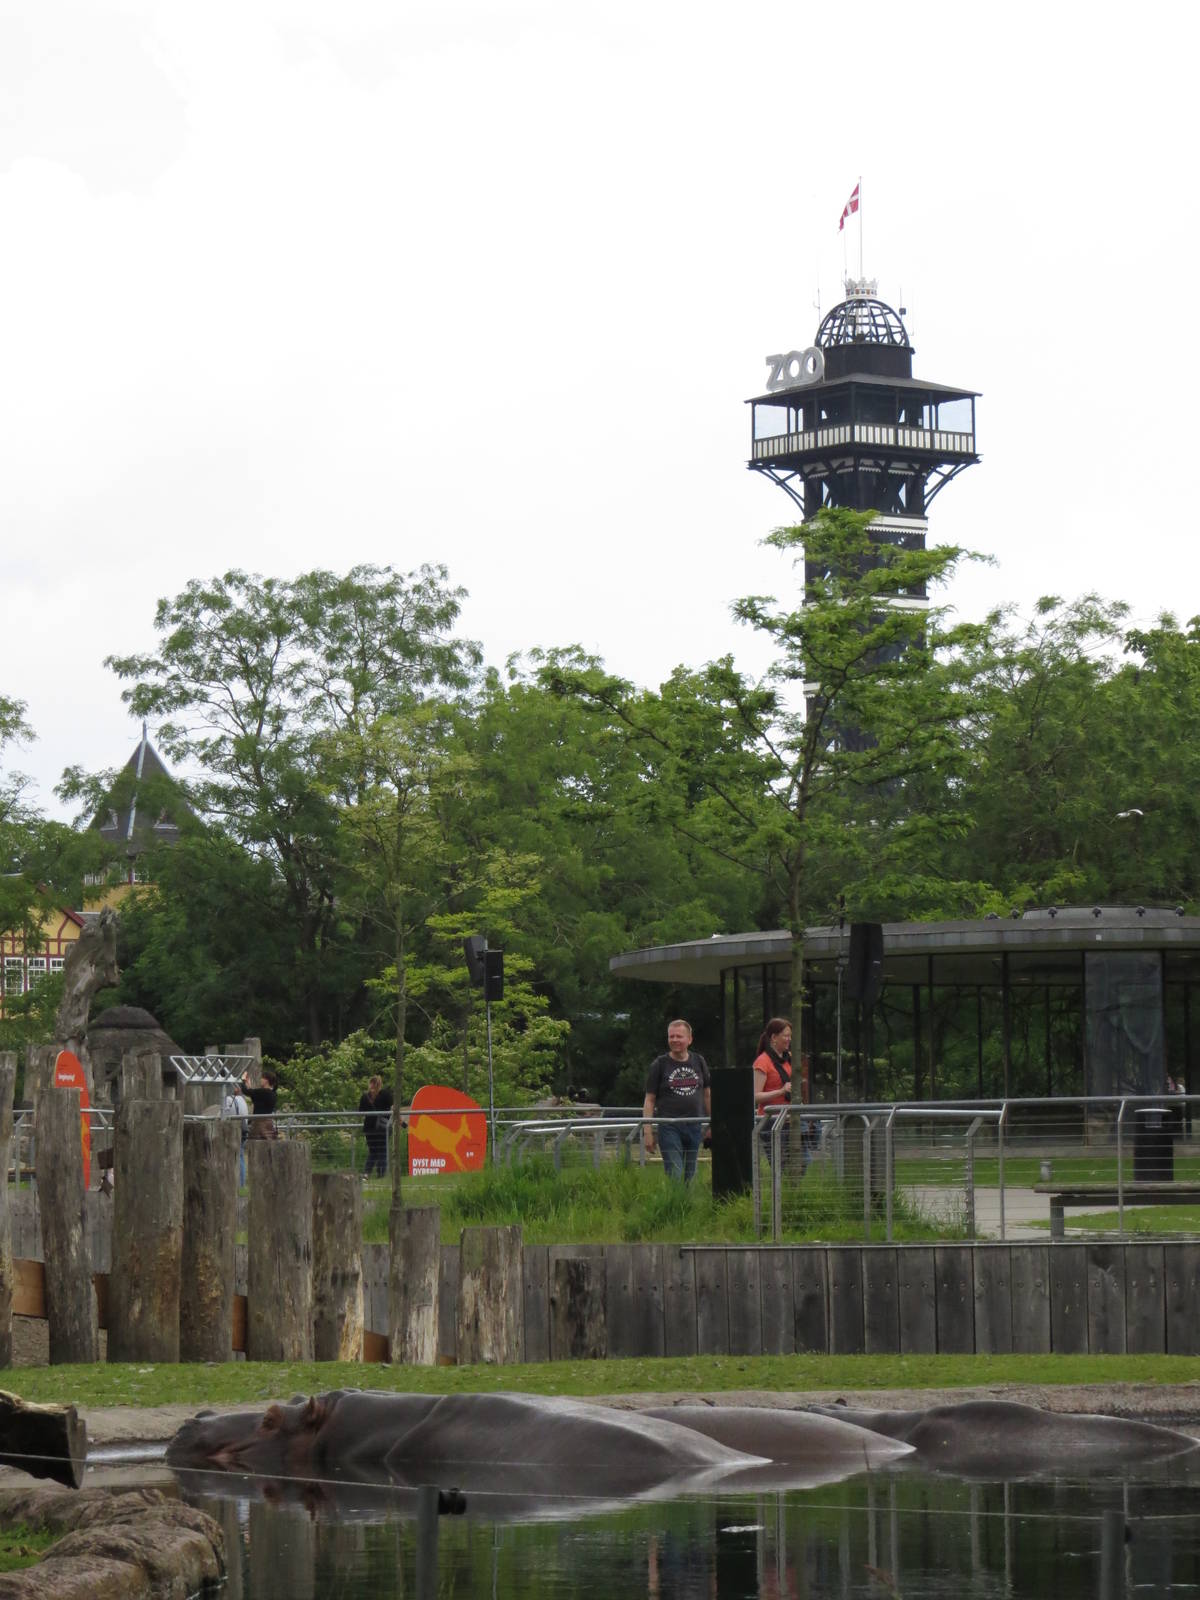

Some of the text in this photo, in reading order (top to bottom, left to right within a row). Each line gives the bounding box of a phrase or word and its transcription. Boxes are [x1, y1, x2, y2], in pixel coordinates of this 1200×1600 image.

[765, 345, 825, 392] ZOO
[412, 1158, 446, 1168] DYST MED
